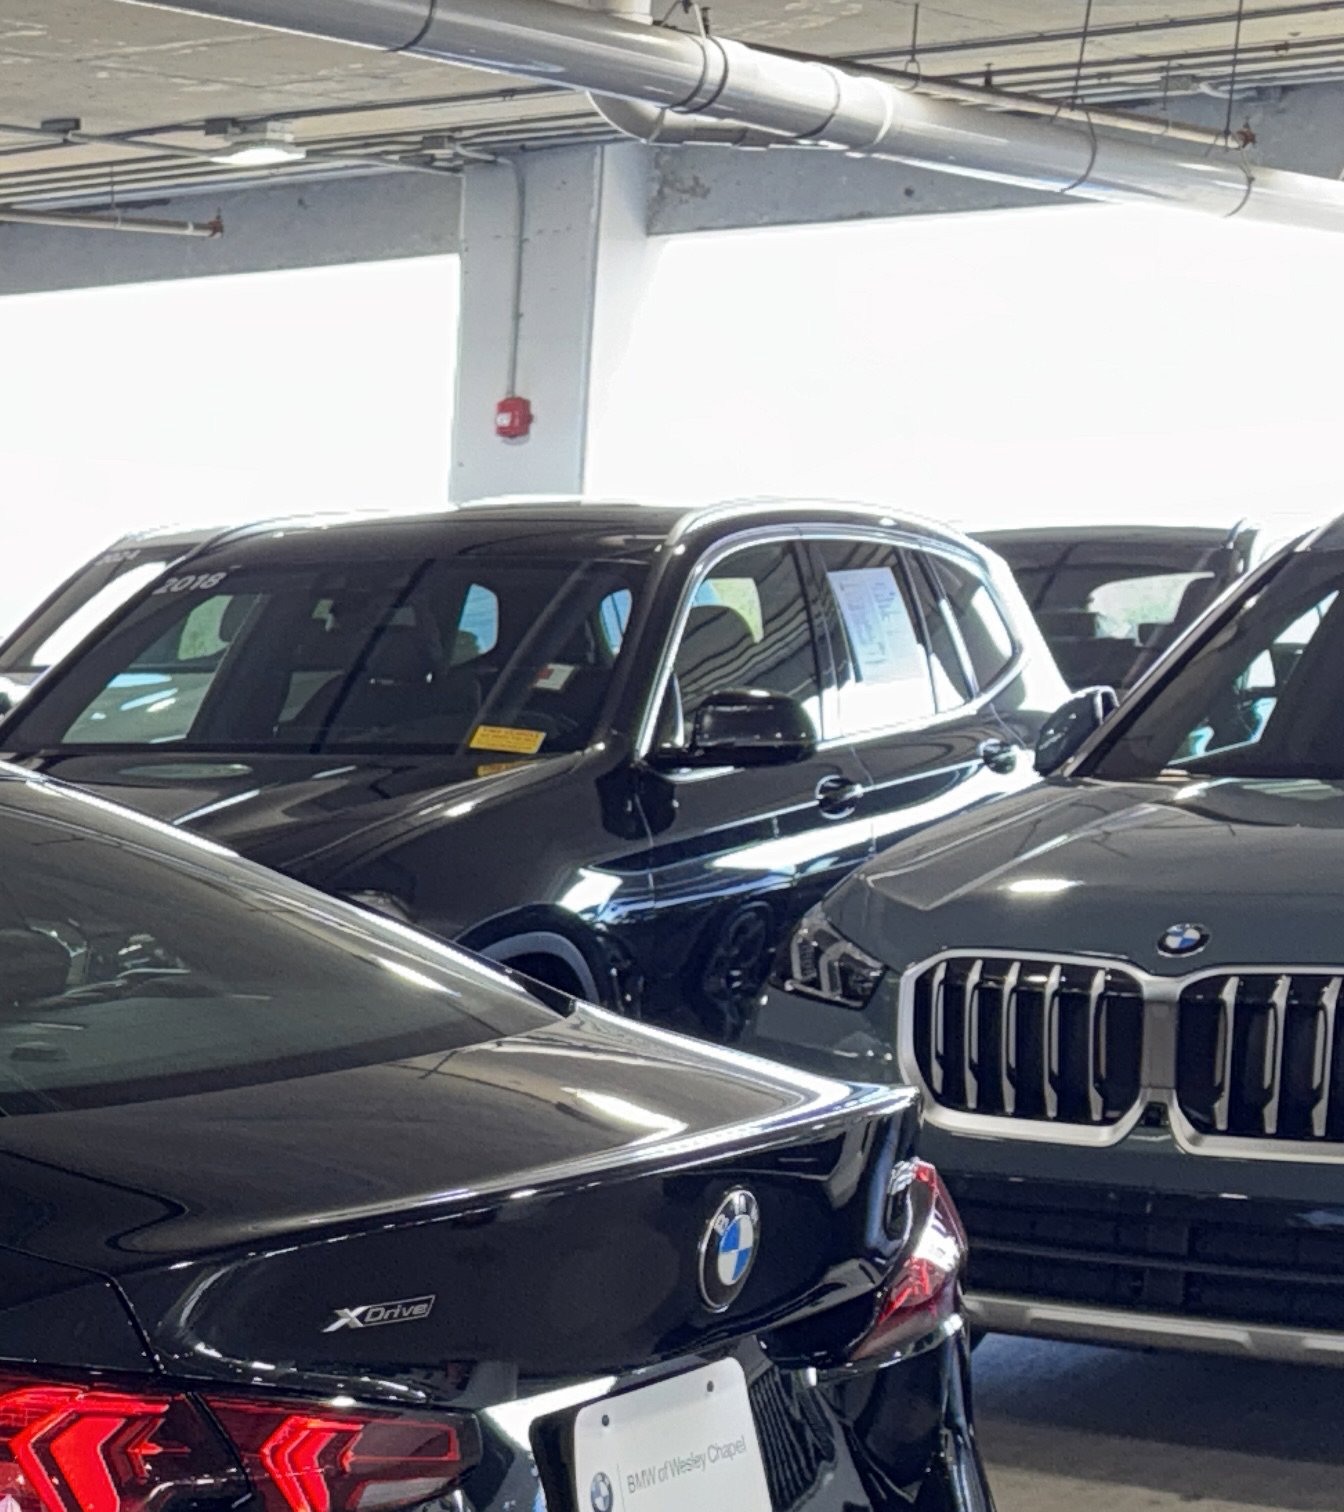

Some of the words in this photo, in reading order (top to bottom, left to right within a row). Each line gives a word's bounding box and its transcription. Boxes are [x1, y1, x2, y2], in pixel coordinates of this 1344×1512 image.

[151, 571, 227, 596] 2018
[627, 1465, 657, 1494] BMW
[658, 1460, 669, 1482] of
[668, 1451, 706, 1478] Wesley
[707, 1434, 747, 1464] Chapel
